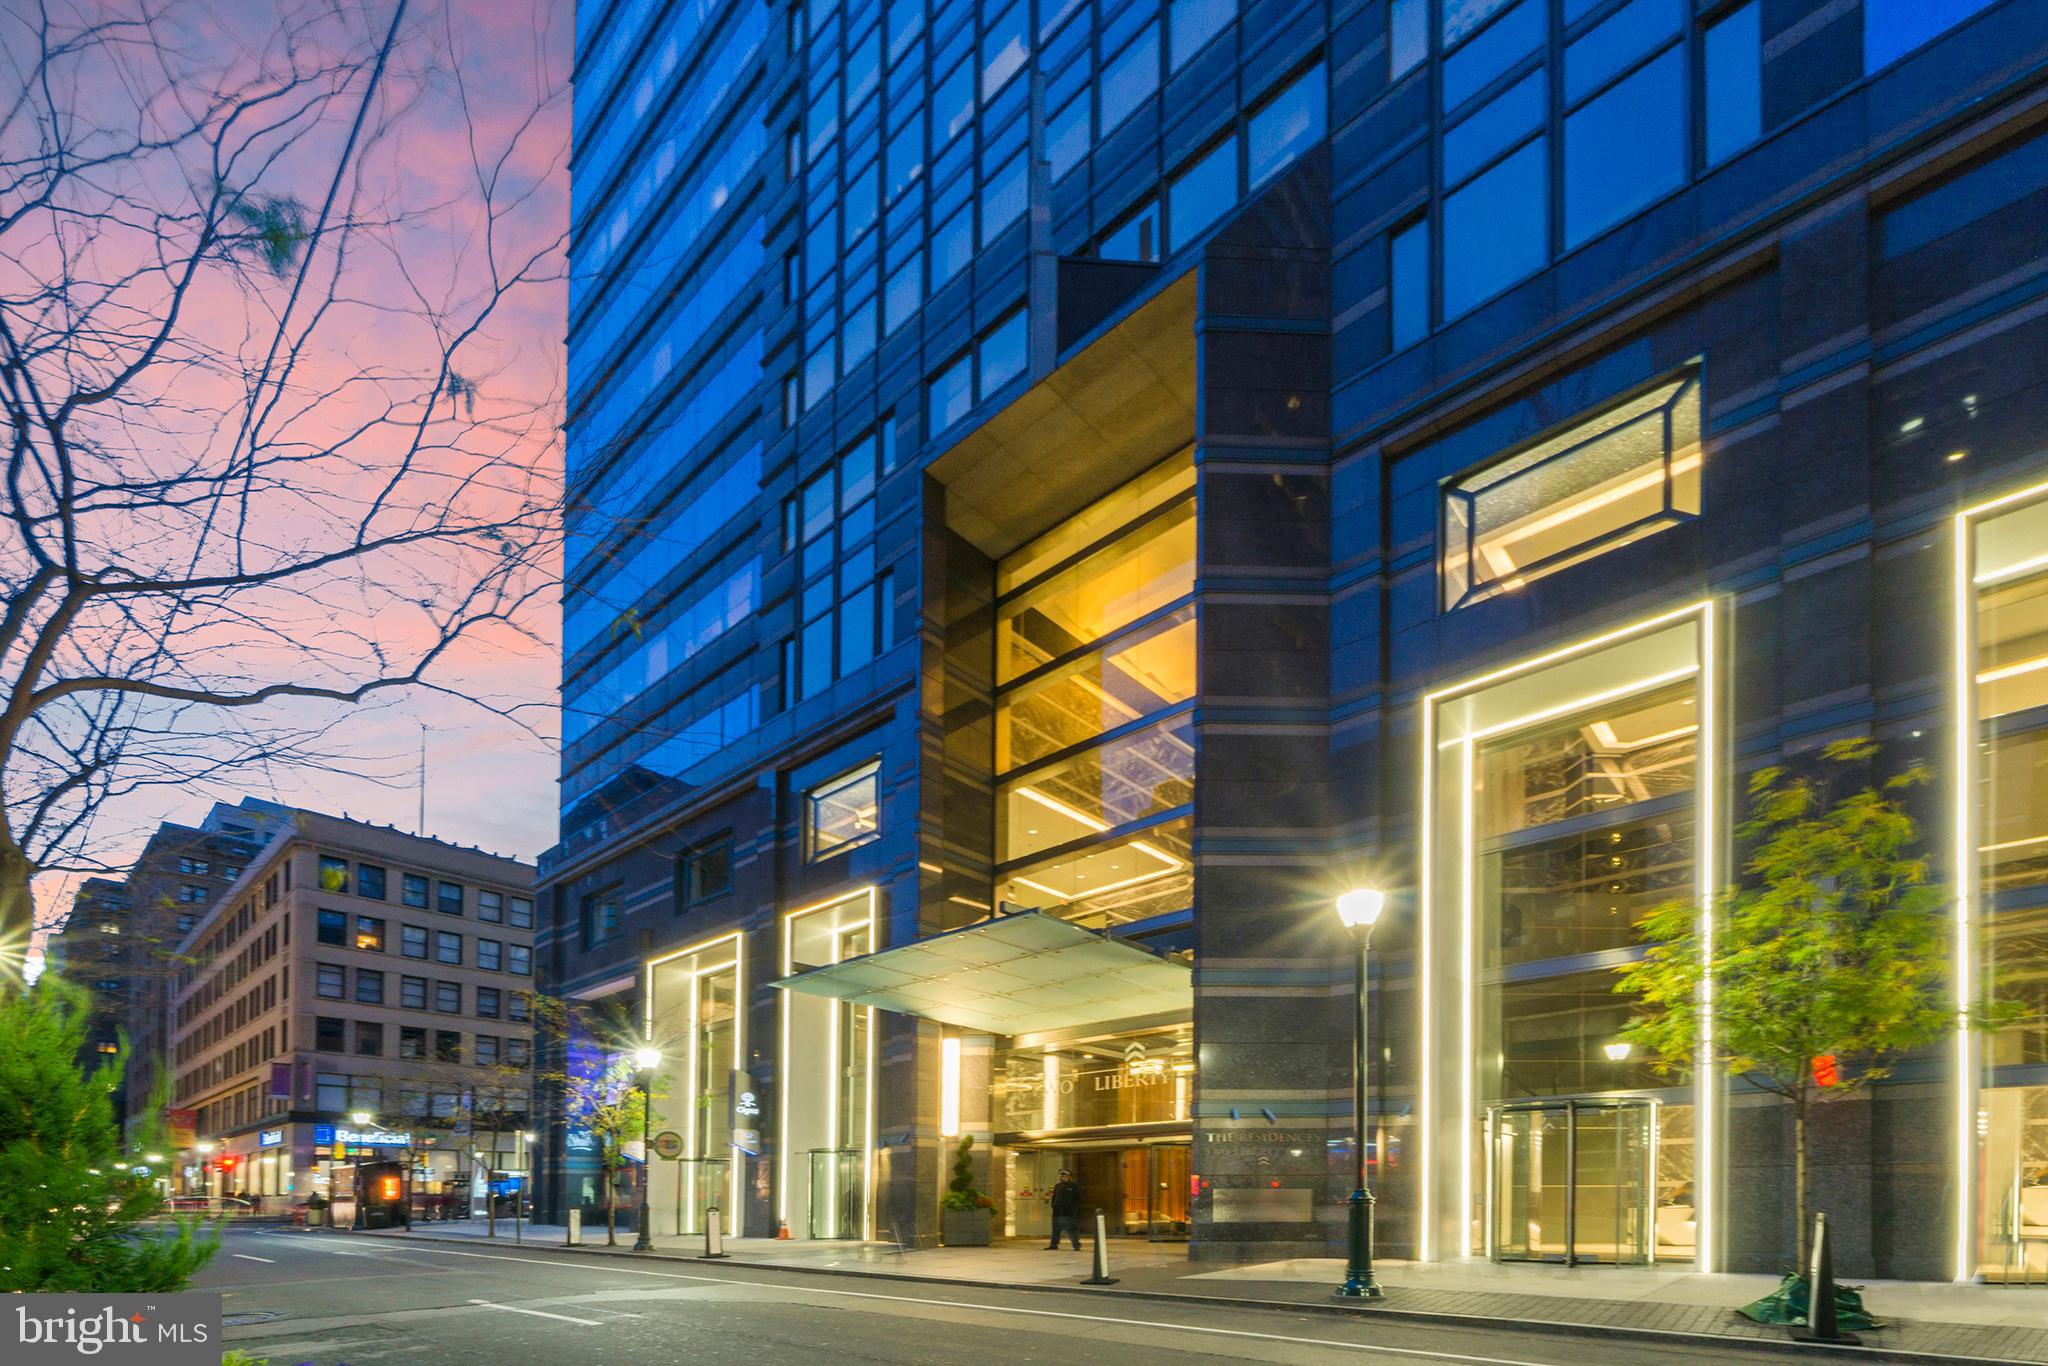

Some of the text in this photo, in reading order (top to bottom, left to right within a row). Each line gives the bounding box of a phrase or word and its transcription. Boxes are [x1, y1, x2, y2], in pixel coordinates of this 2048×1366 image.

[1094, 1073, 1169, 1091] LIBERTY
[335, 1129, 410, 1145] Beneficial
[1206, 1132, 1321, 1143] THE RESIDENCES
